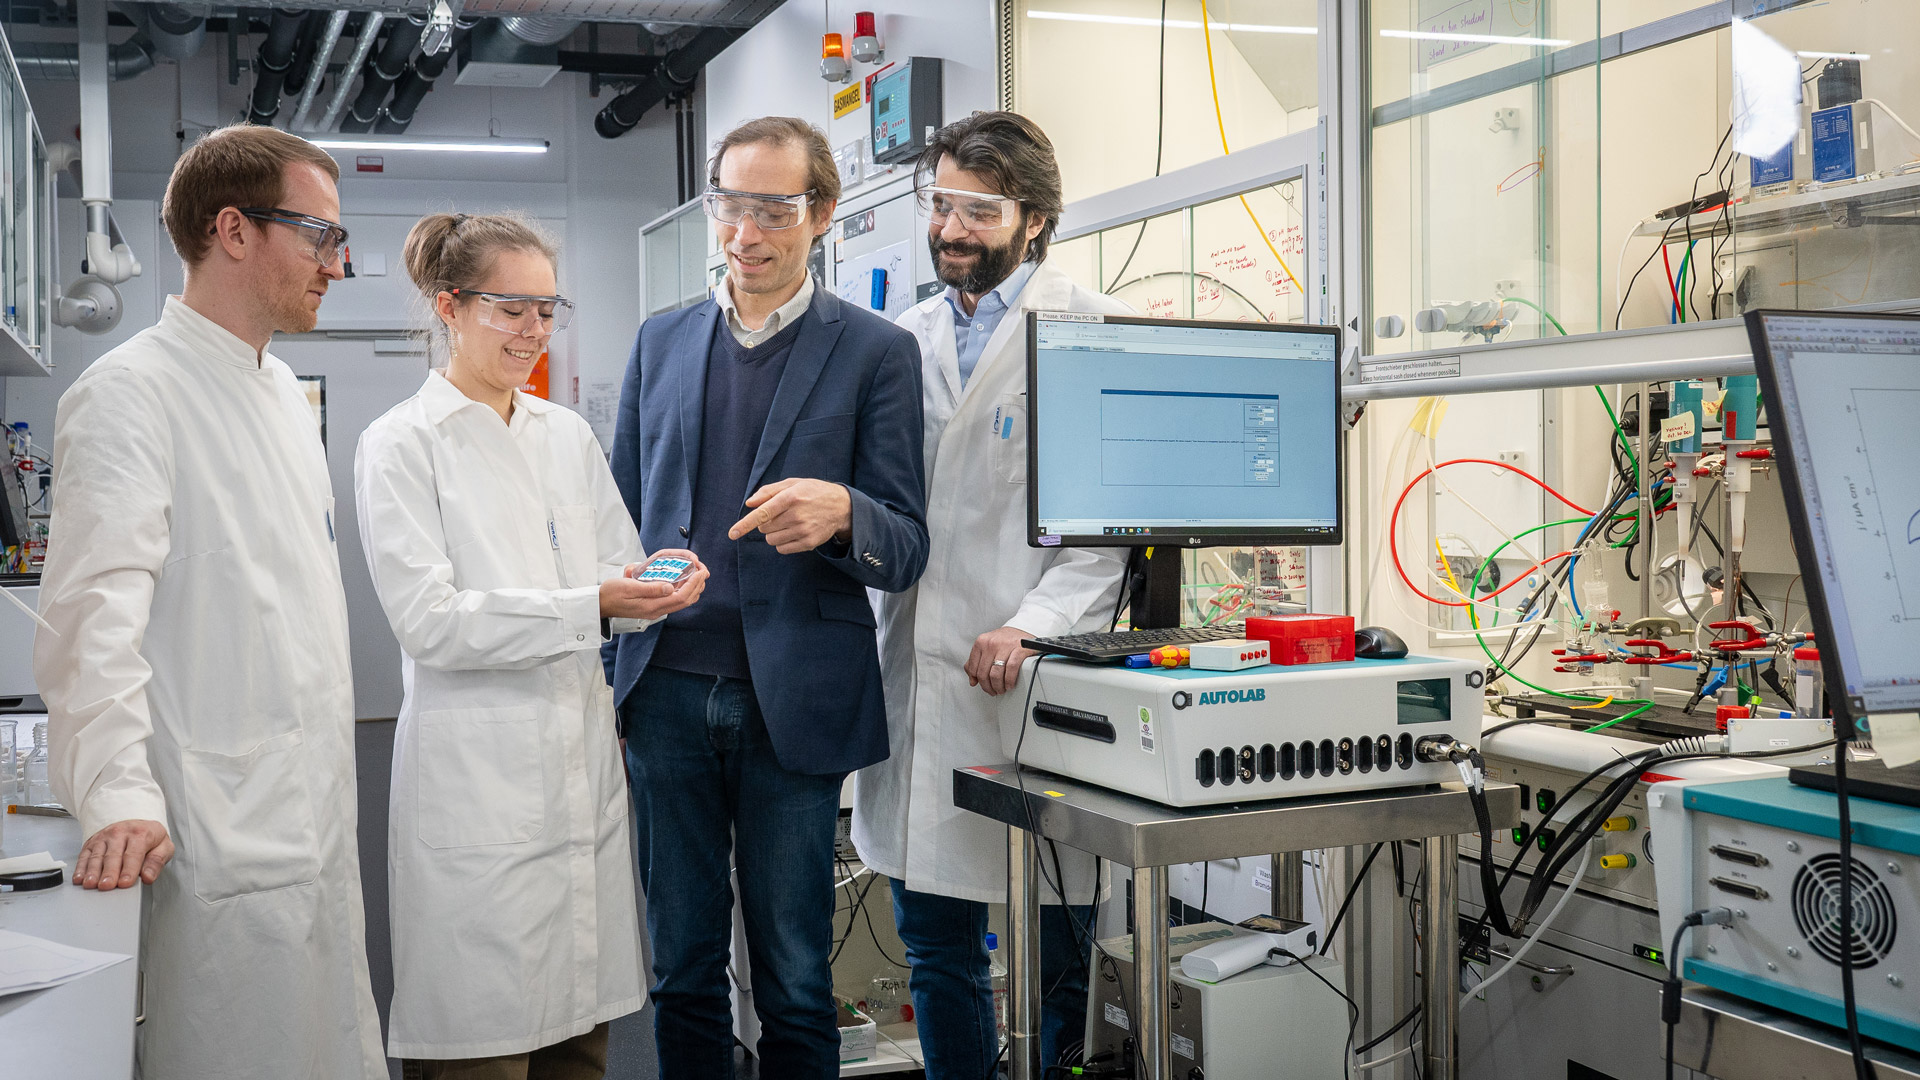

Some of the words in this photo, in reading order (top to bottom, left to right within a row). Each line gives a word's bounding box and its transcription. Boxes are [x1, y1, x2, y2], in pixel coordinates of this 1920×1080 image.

[834, 88, 860, 113] GASMANGEL
[1375, 364, 1402, 372] Frontschieber
[1402, 362, 1428, 370] geschlossen
[1198, 688, 1266, 705] AUTOLAB
[1038, 703, 1069, 715] POTENTIOSTAT
[1072, 710, 1104, 722] GALVANOSTAT
